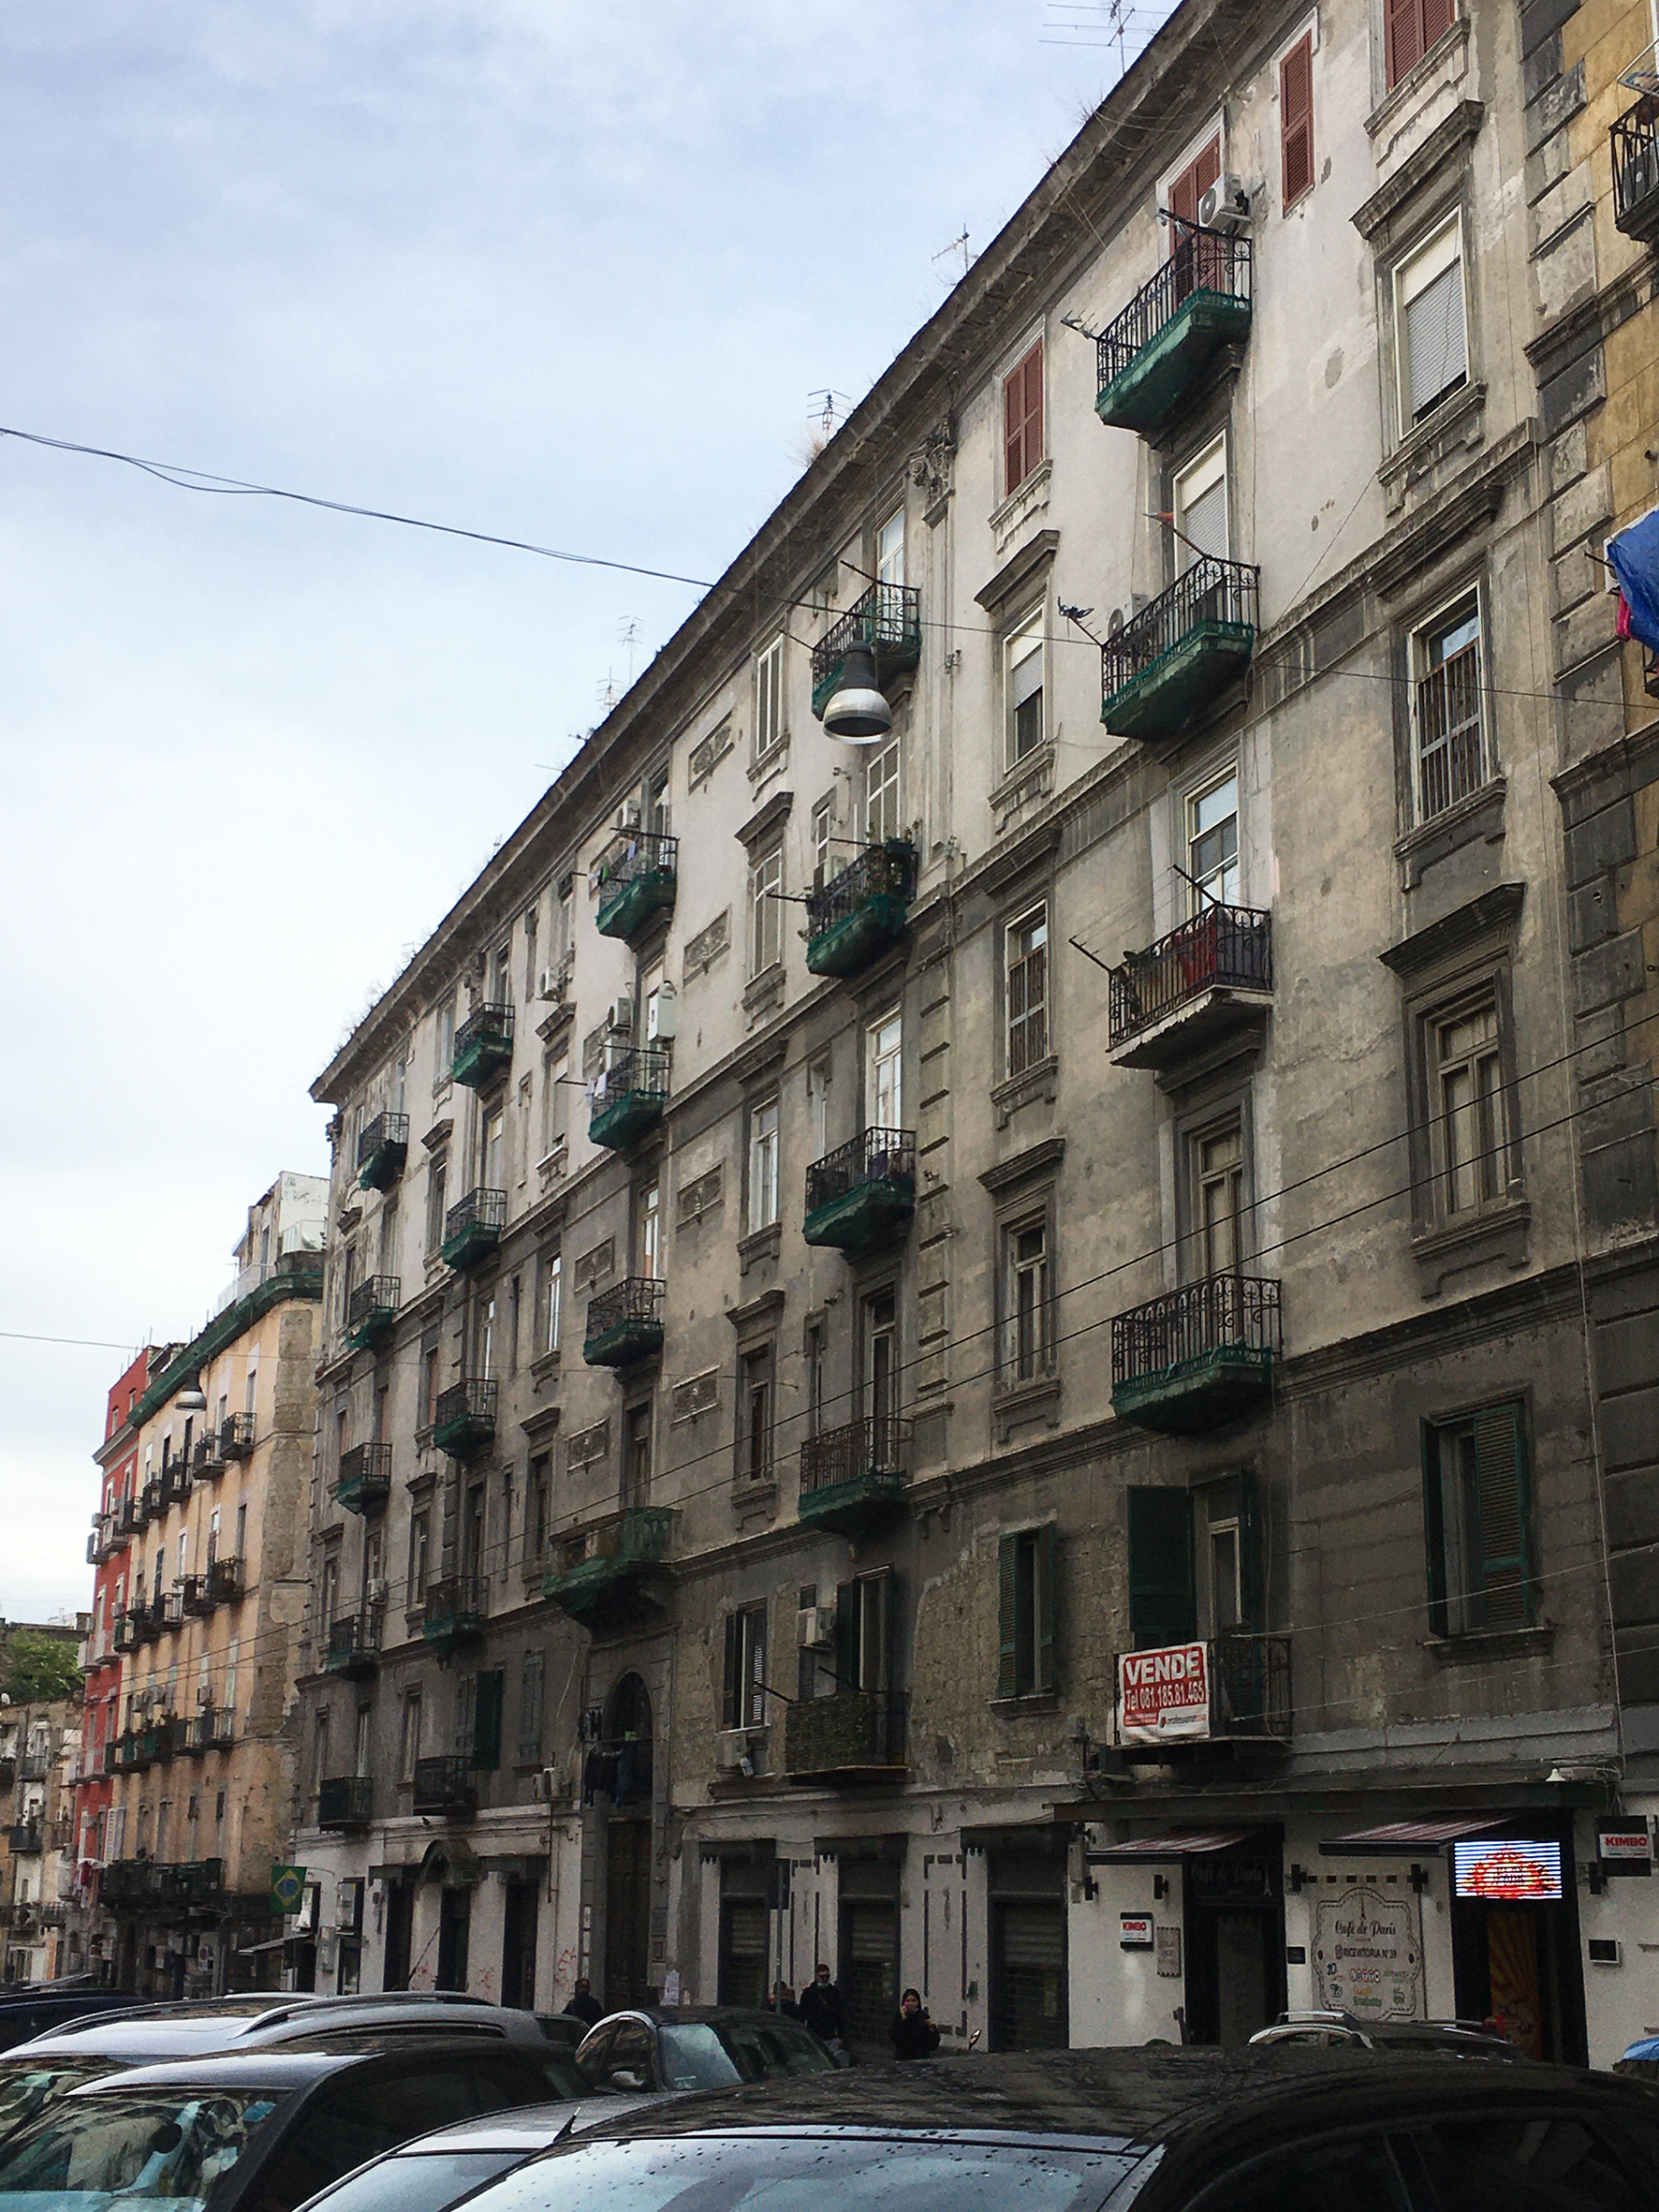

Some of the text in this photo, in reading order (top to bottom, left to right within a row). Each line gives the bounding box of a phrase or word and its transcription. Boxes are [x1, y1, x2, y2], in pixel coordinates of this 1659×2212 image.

[1125, 1651, 1200, 1686] VENDE
[1125, 1689, 1138, 1711] Tel
[1605, 1836, 1648, 1847] KIMBO
[1123, 1922, 1147, 1932] KIMBO
[1370, 1920, 1397, 1937] Paris
